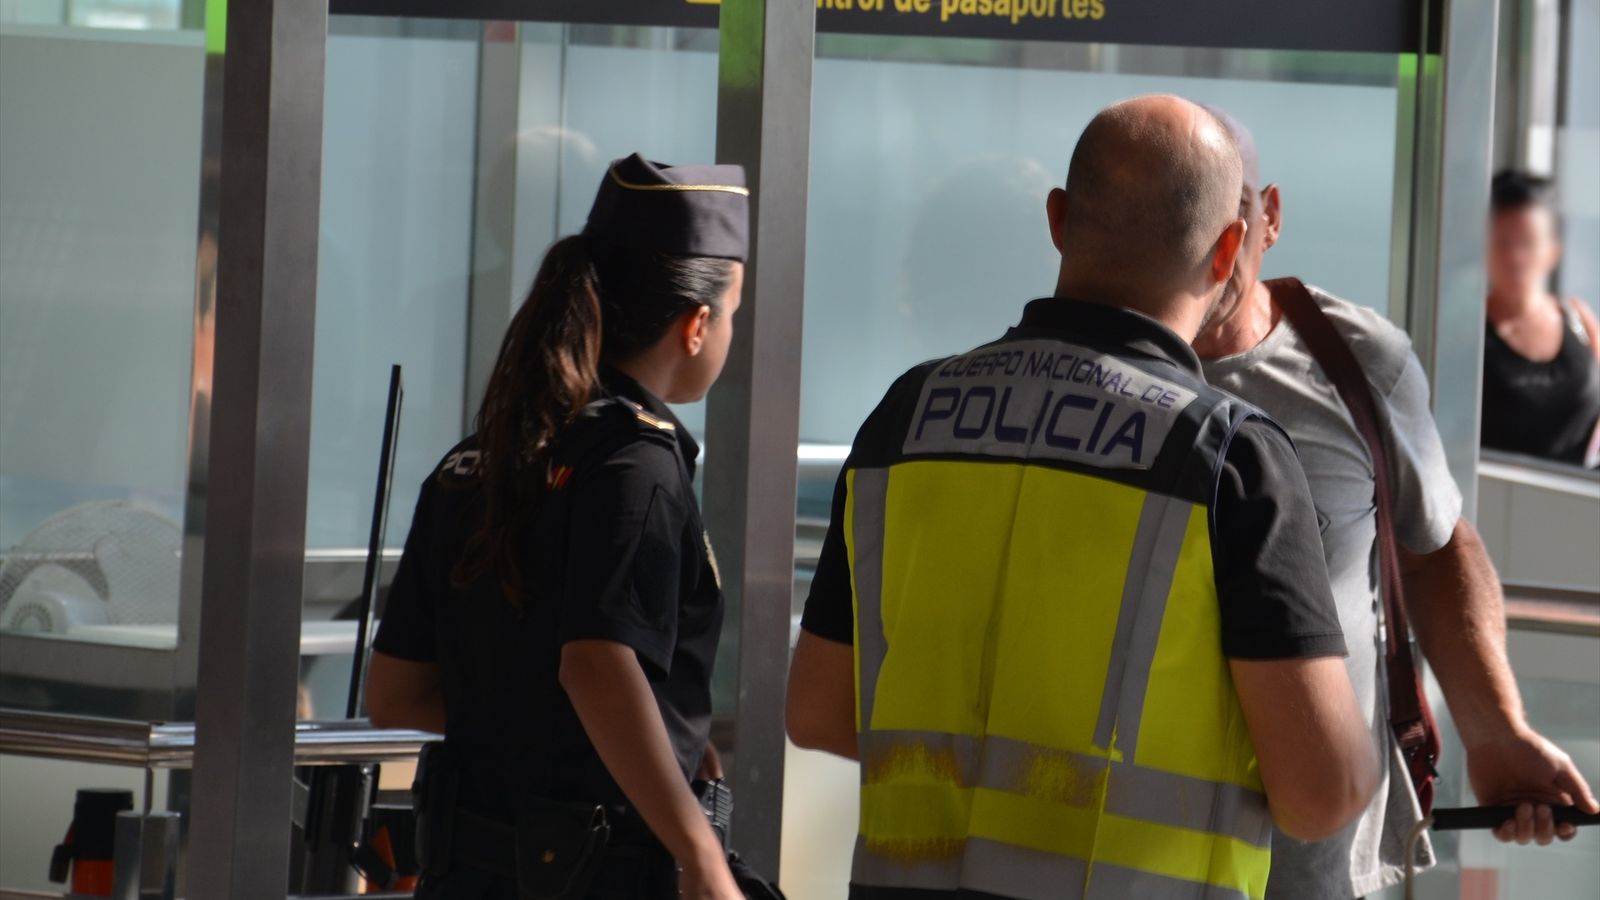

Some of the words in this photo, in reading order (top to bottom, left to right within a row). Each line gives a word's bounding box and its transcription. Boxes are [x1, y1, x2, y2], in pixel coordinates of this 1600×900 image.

[938, 350, 1024, 378] CUERPO
[1022, 350, 1135, 398] NACIONAL
[1139, 384, 1181, 408] DE
[914, 386, 1147, 464] POLICIA
